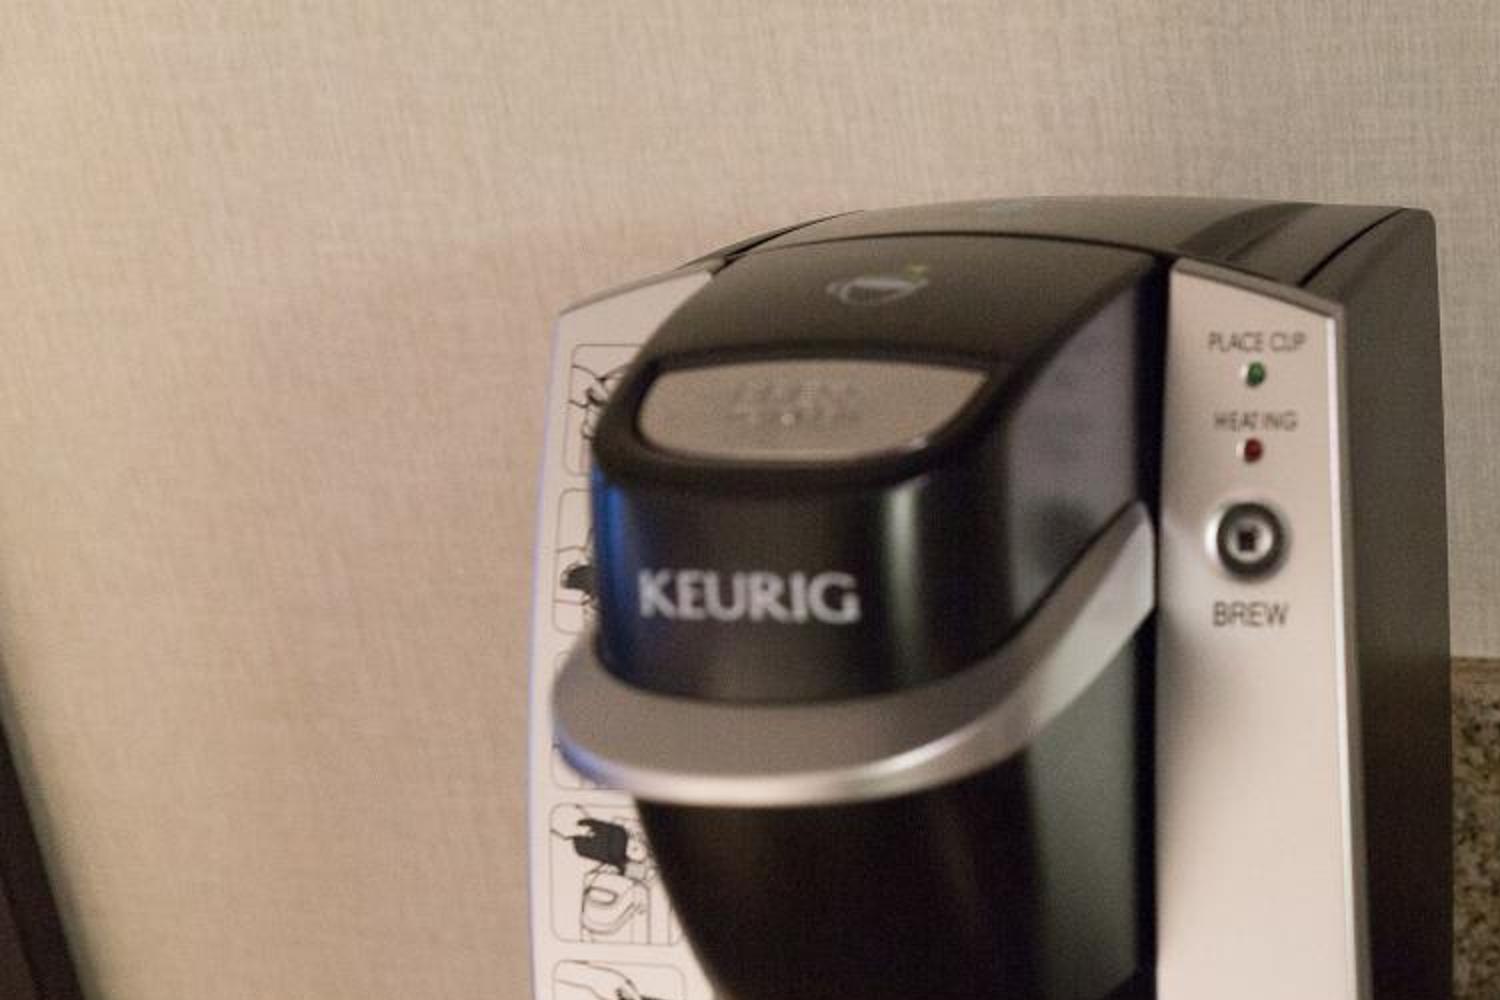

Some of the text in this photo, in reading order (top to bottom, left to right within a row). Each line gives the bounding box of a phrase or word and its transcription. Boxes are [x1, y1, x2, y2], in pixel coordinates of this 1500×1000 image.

[1208, 332, 1307, 352] PLACE CUP
[1213, 411, 1298, 432] HEATING
[637, 568, 862, 625] KEURIG
[1212, 602, 1288, 628] BREW
